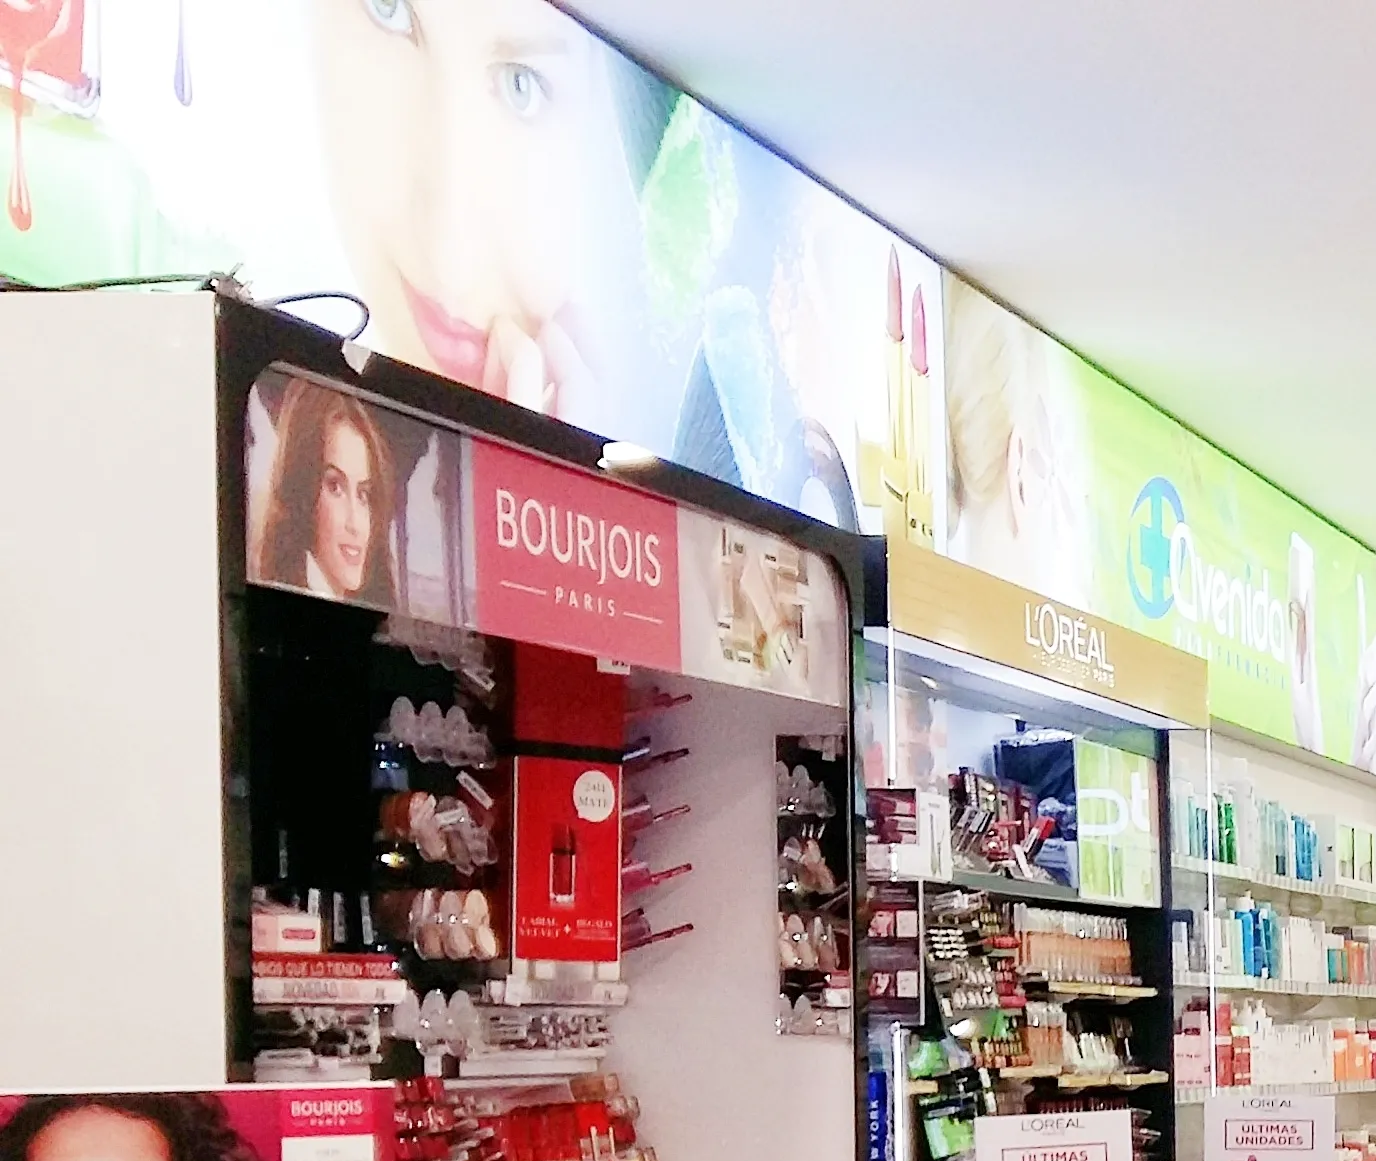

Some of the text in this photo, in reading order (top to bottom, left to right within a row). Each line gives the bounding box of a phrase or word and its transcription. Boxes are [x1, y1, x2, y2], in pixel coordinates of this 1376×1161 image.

[496, 488, 662, 587] BOURJOIS
[555, 586, 615, 617] PARIS
[1024, 601, 1115, 672] L'ORÉAL
[291, 1099, 363, 1118] BOURJOIS
[869, 1099, 880, 1142] YORK
[1235, 1136, 1304, 1146] UNIDADES
